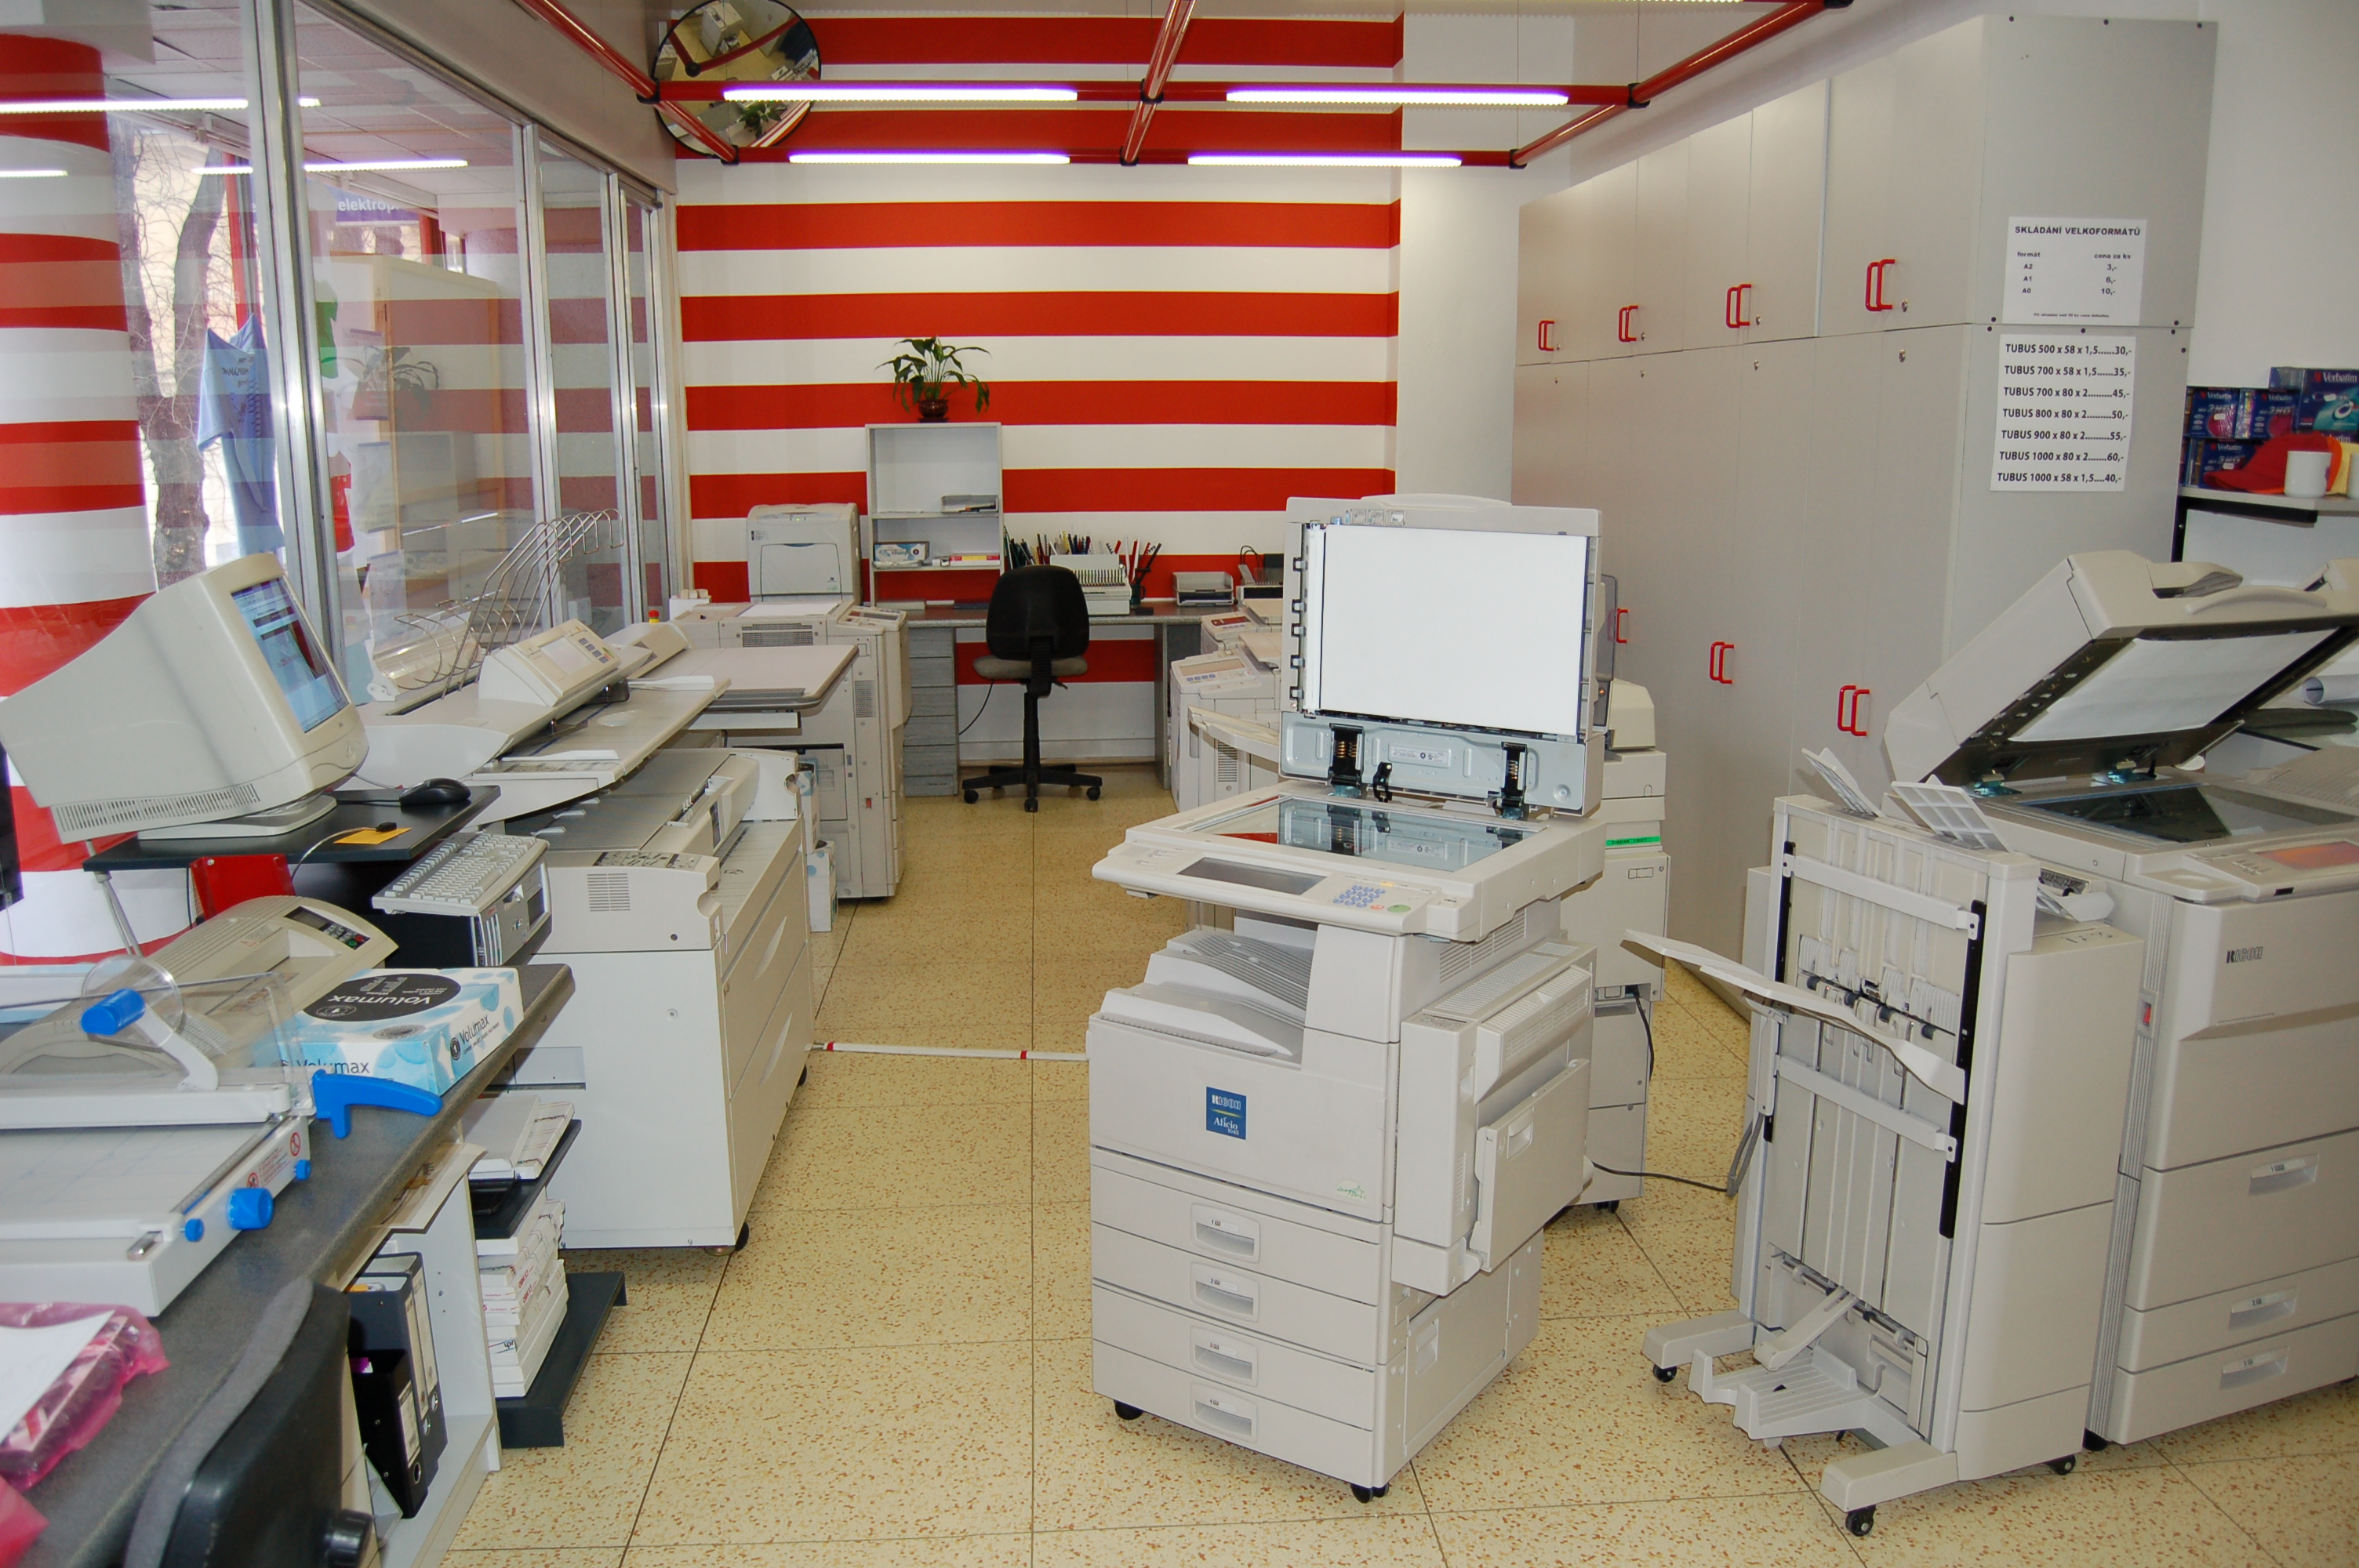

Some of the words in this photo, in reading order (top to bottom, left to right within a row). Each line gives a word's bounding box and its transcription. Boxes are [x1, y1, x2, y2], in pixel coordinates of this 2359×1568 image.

[2015, 225, 2062, 234] SKLÁDÁNÍ
[2005, 343, 2036, 354] TUBUS
[2038, 344, 2055, 354] 500
[2064, 345, 2075, 354] 58
[2005, 365, 2034, 375] TUBUS
[2037, 366, 2053, 376] 700
[2063, 366, 2074, 376] 58
[2323, 372, 2357, 383] Verbatim
[2004, 387, 2034, 396] TUBUS
[2036, 387, 2053, 397] 700
[2062, 388, 2073, 397] 80
[2207, 391, 2232, 401] Verbatim
[2003, 408, 2033, 418] TUBUS
[2035, 409, 2052, 418] 800
[2061, 409, 2072, 419] 80
[2001, 430, 2032, 439] TUBUS
[2034, 430, 2051, 440] 900
[2059, 431, 2070, 440] 80
[2000, 451, 2030, 461] TUBUS
[2033, 452, 2054, 461] 1000
[2063, 452, 2074, 461] 80
[1997, 472, 2027, 481] TUBUS
[2030, 473, 2052, 482] 1000
[2060, 474, 2071, 482] 58
[2226, 946, 2263, 964] RICOH
[327, 995, 431, 1006] Volumax
[460, 1014, 489, 1045] Volumax
[1212, 1094, 1241, 1110] RICOH
[1213, 1116, 1238, 1130] Aficio
